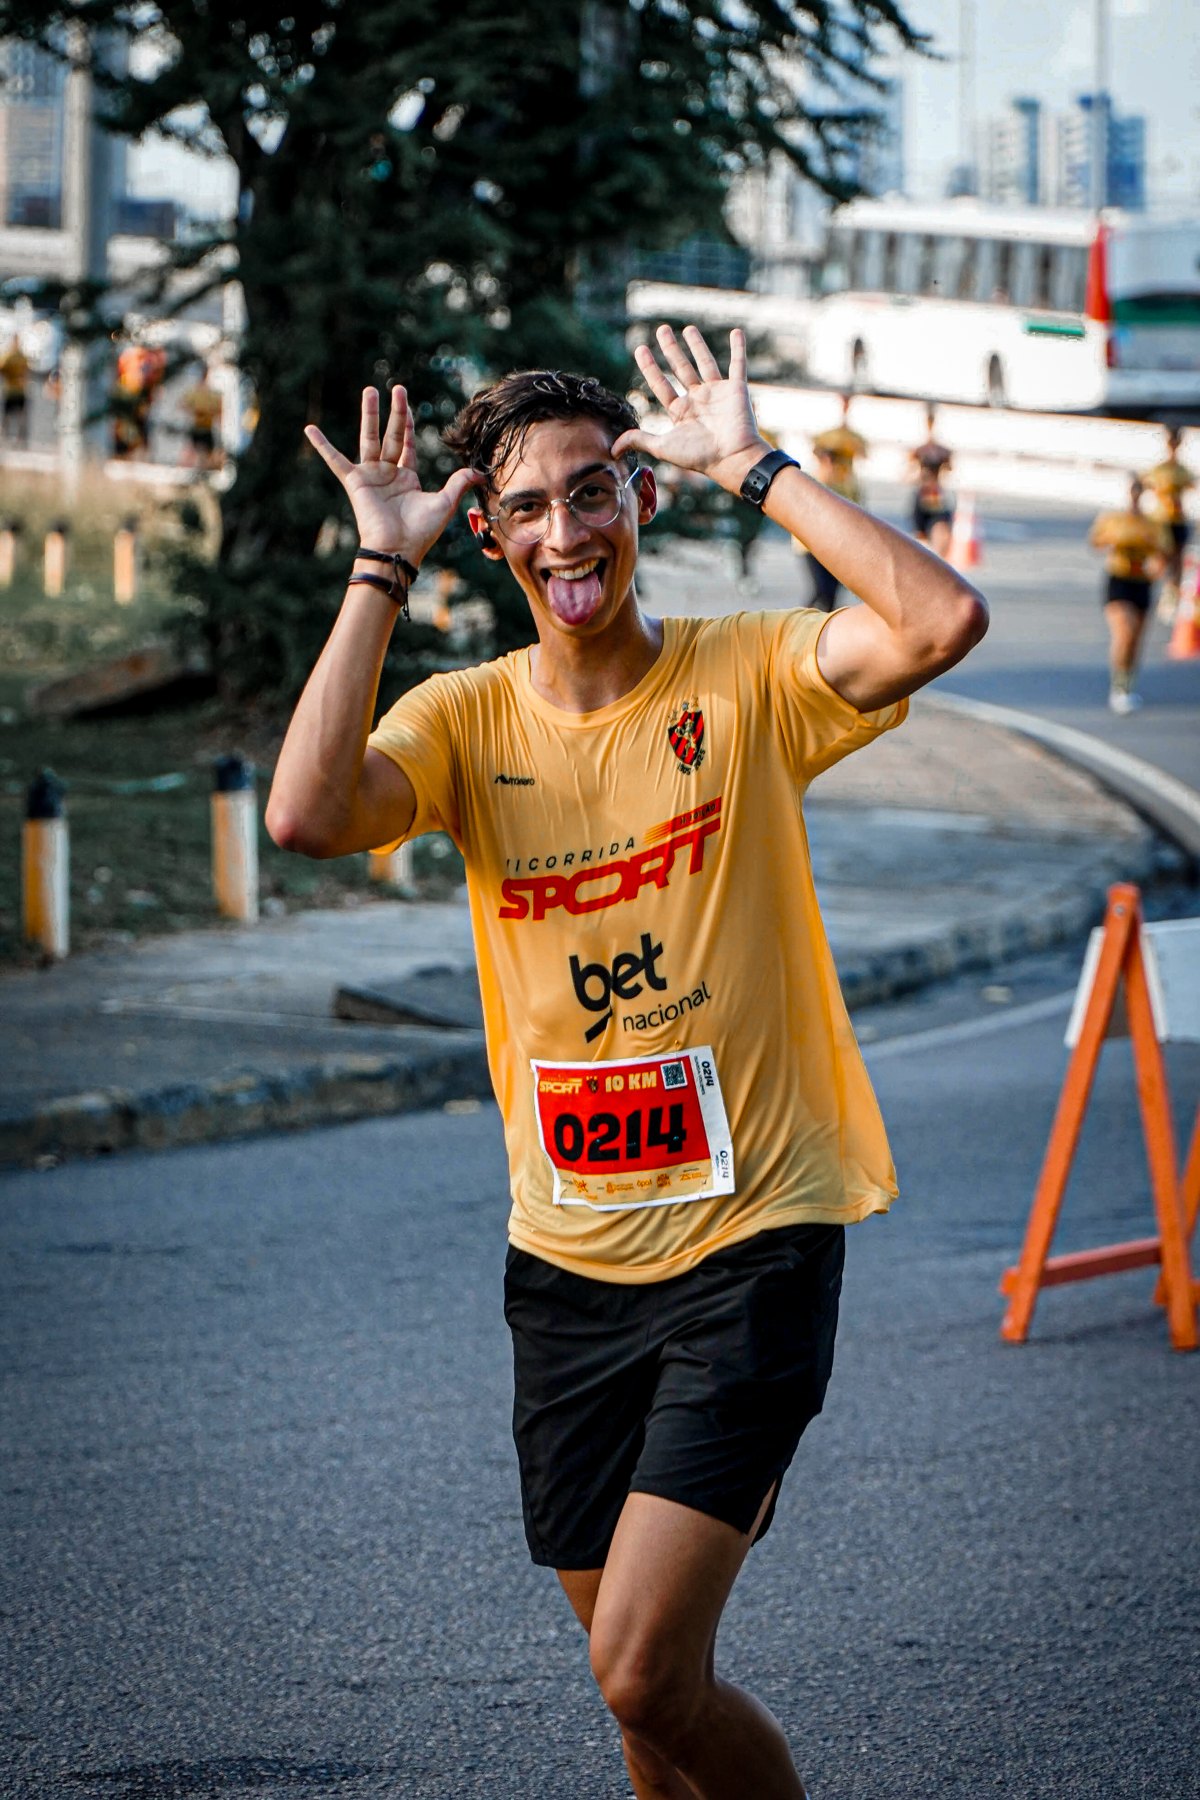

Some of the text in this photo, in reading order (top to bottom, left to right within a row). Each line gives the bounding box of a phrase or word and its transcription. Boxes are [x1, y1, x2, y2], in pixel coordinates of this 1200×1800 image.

[499, 817, 721, 921] SPORT
[528, 836, 635, 871] CORRIDA
[569, 933, 667, 1012] bet
[623, 981, 711, 1032] nacional
[605, 1070, 657, 1093] 10 KM
[701, 1060, 714, 1087] 0214
[554, 1103, 687, 1162] 0214
[720, 1150, 729, 1179] 0214
